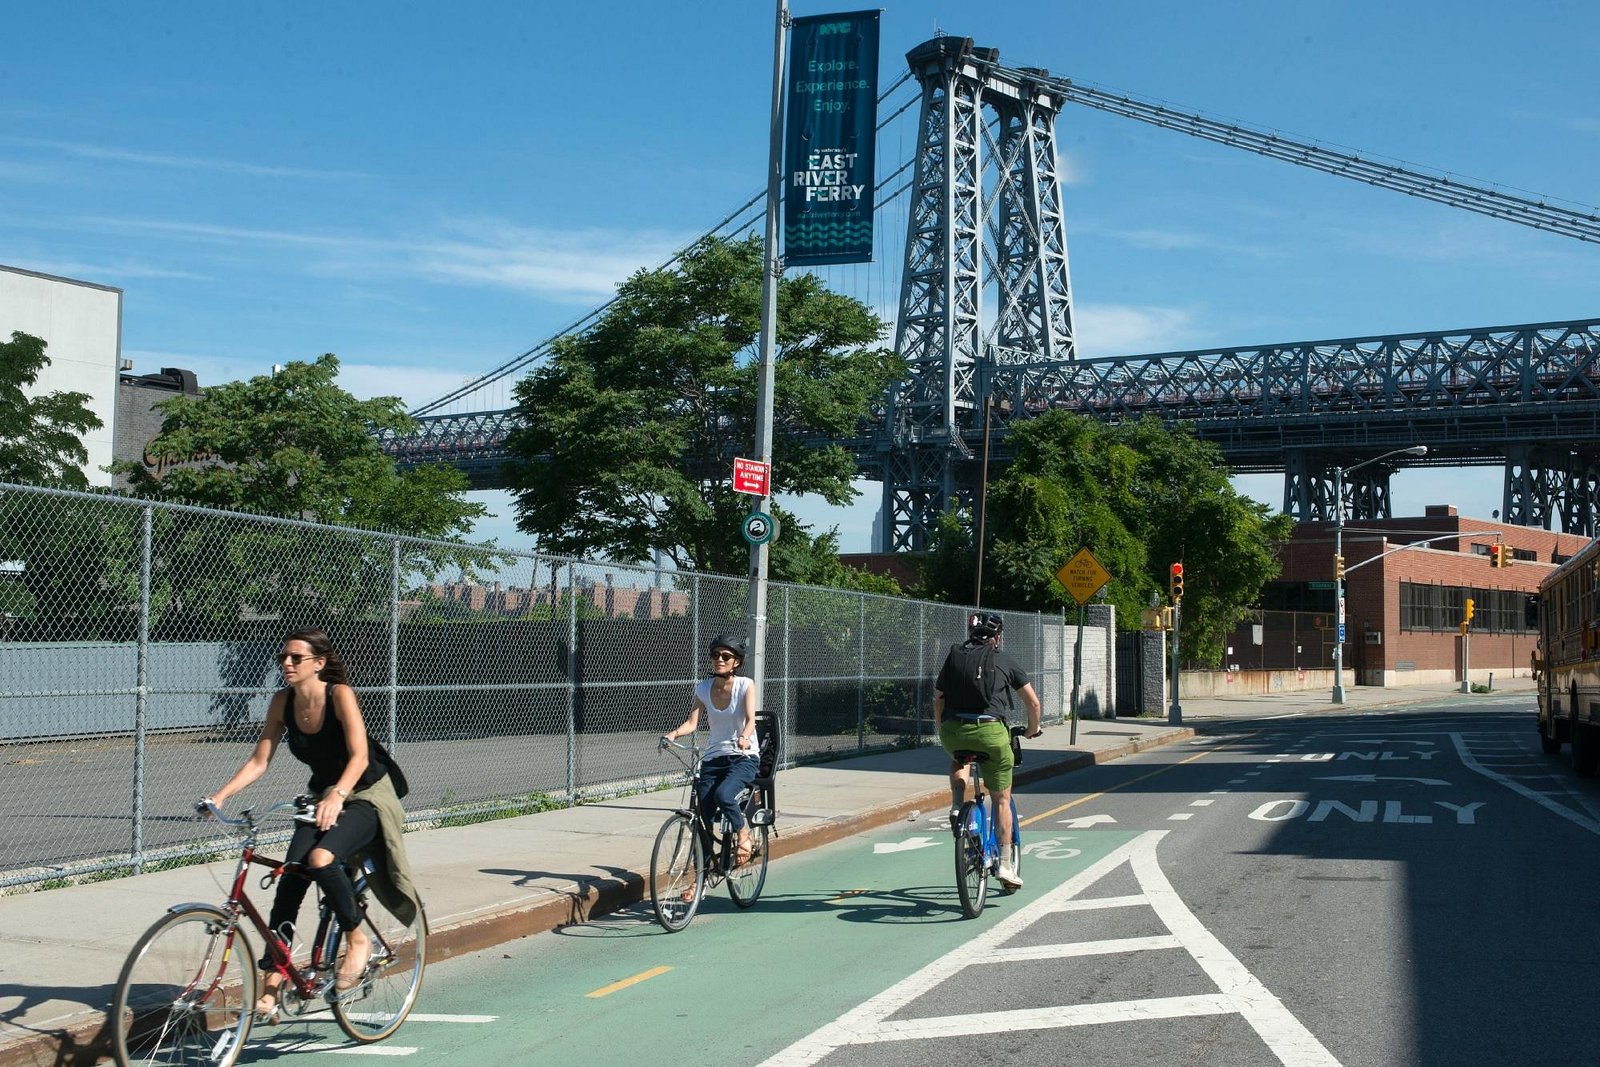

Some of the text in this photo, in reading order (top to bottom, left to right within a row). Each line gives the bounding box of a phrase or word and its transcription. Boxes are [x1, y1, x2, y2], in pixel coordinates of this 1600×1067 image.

[808, 60, 860, 73] Explore.
[796, 80, 870, 94] Experience.
[814, 99, 851, 113] Enjoy.
[808, 153, 858, 170] EAST
[793, 170, 848, 187] RIVER
[806, 184, 866, 202] FERRY
[744, 463, 768, 474] STANDING
[740, 471, 764, 481] ANYTIME
[1300, 751, 1441, 761] ONLY
[1247, 799, 1488, 824] ONLY
